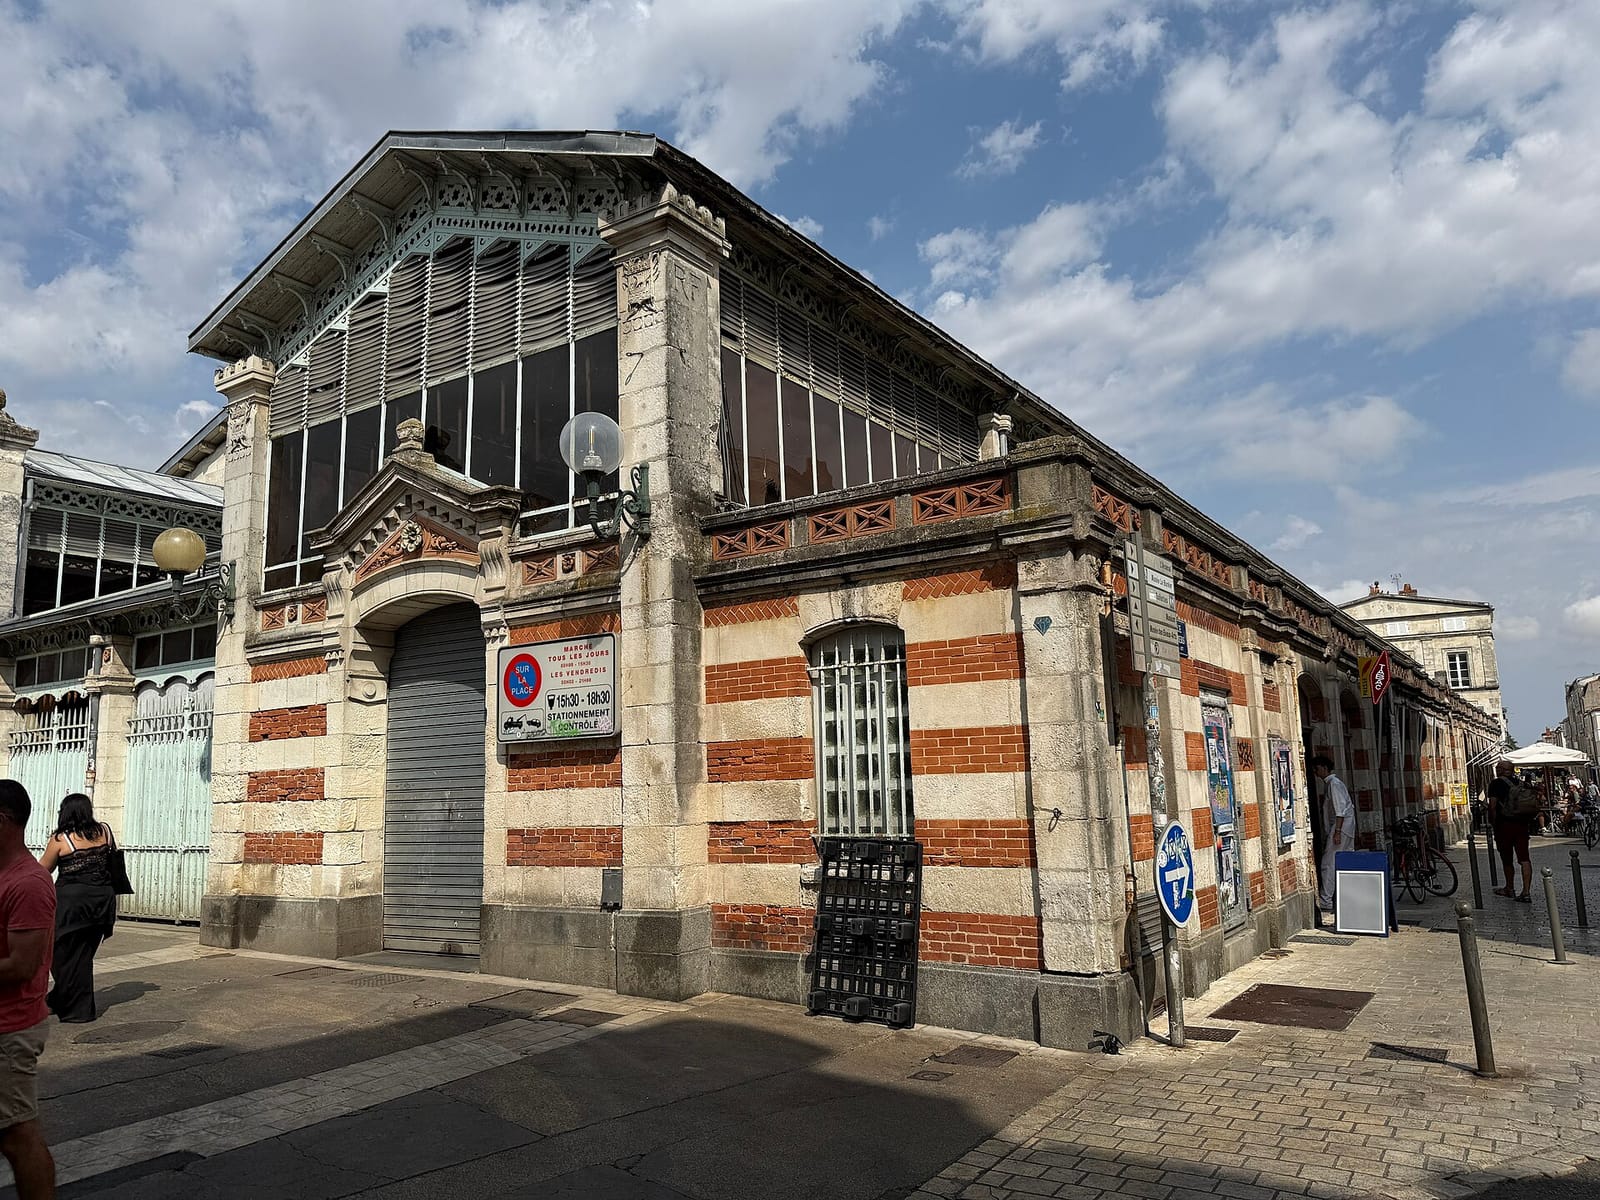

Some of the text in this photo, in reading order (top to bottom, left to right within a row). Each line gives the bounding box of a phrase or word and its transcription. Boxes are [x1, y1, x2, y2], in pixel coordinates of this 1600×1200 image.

[585, 650, 609, 658] JOURS
[515, 665, 530, 674] SUR
[566, 667, 606, 677] VENDREDIS
[1374, 663, 1386, 691] TABAC
[511, 686, 534, 696] PLACE
[556, 693, 579, 708] 15h30
[586, 690, 610, 706] 18h30
[547, 708, 610, 721] STATIONNEMENT
